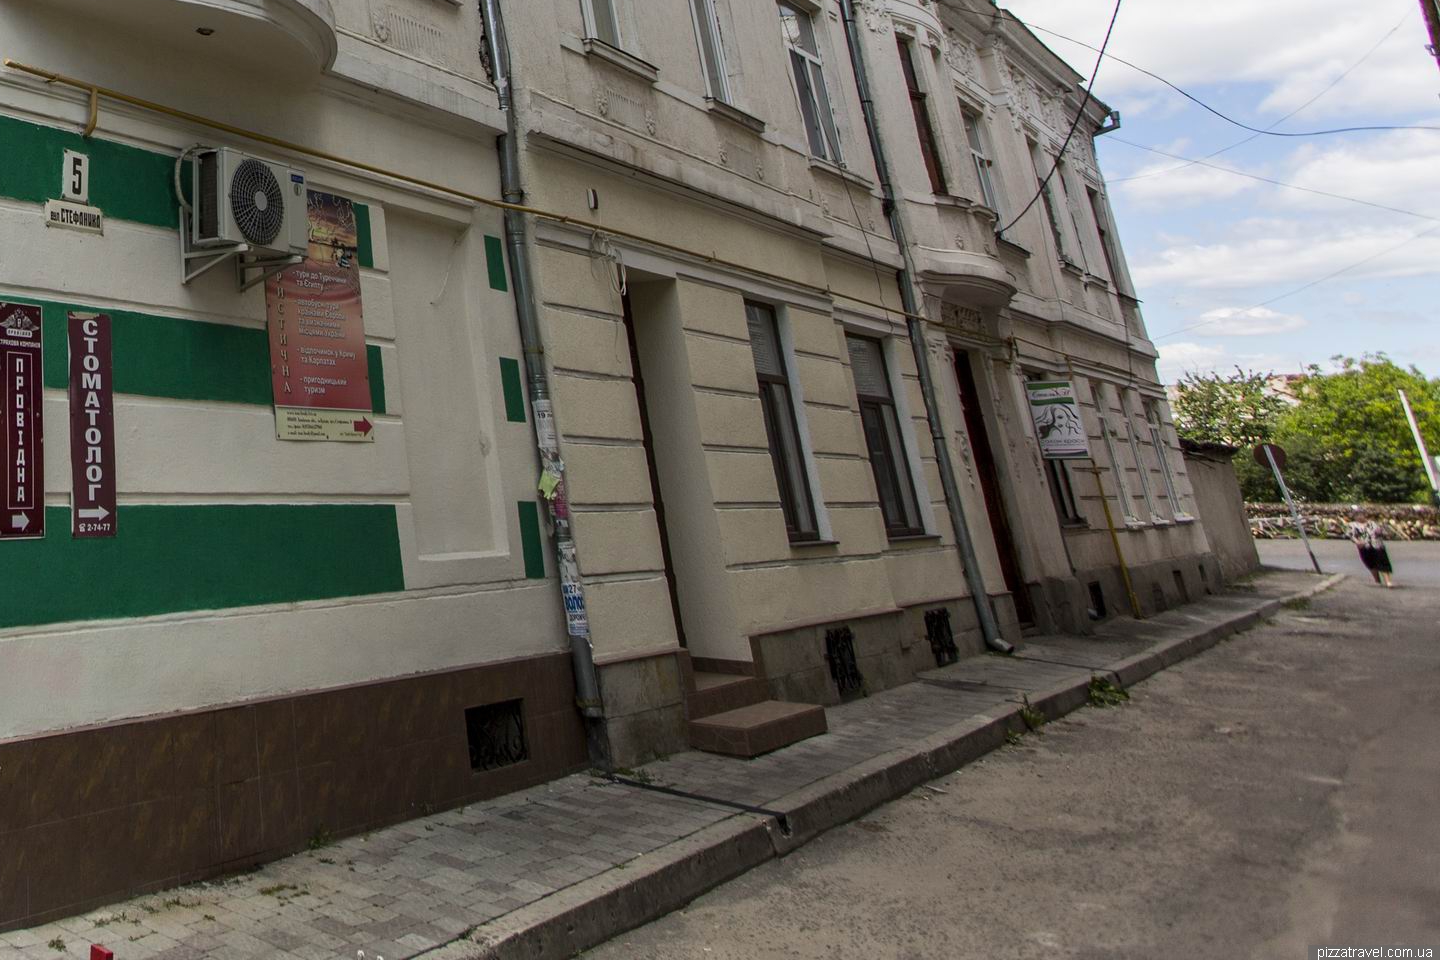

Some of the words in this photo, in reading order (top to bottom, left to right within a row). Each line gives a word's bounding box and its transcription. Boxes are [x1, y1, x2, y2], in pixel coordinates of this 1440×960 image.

[72, 157, 82, 195] 5
[61, 208, 100, 229] СТЕФАНИКА
[276, 272, 291, 392] РИСТИЧНА
[16, 358, 25, 502] ПРОВІДНА
[82, 320, 103, 501] СТОМАТОЛОГ
[87, 523, 110, 531] 2-74-77
